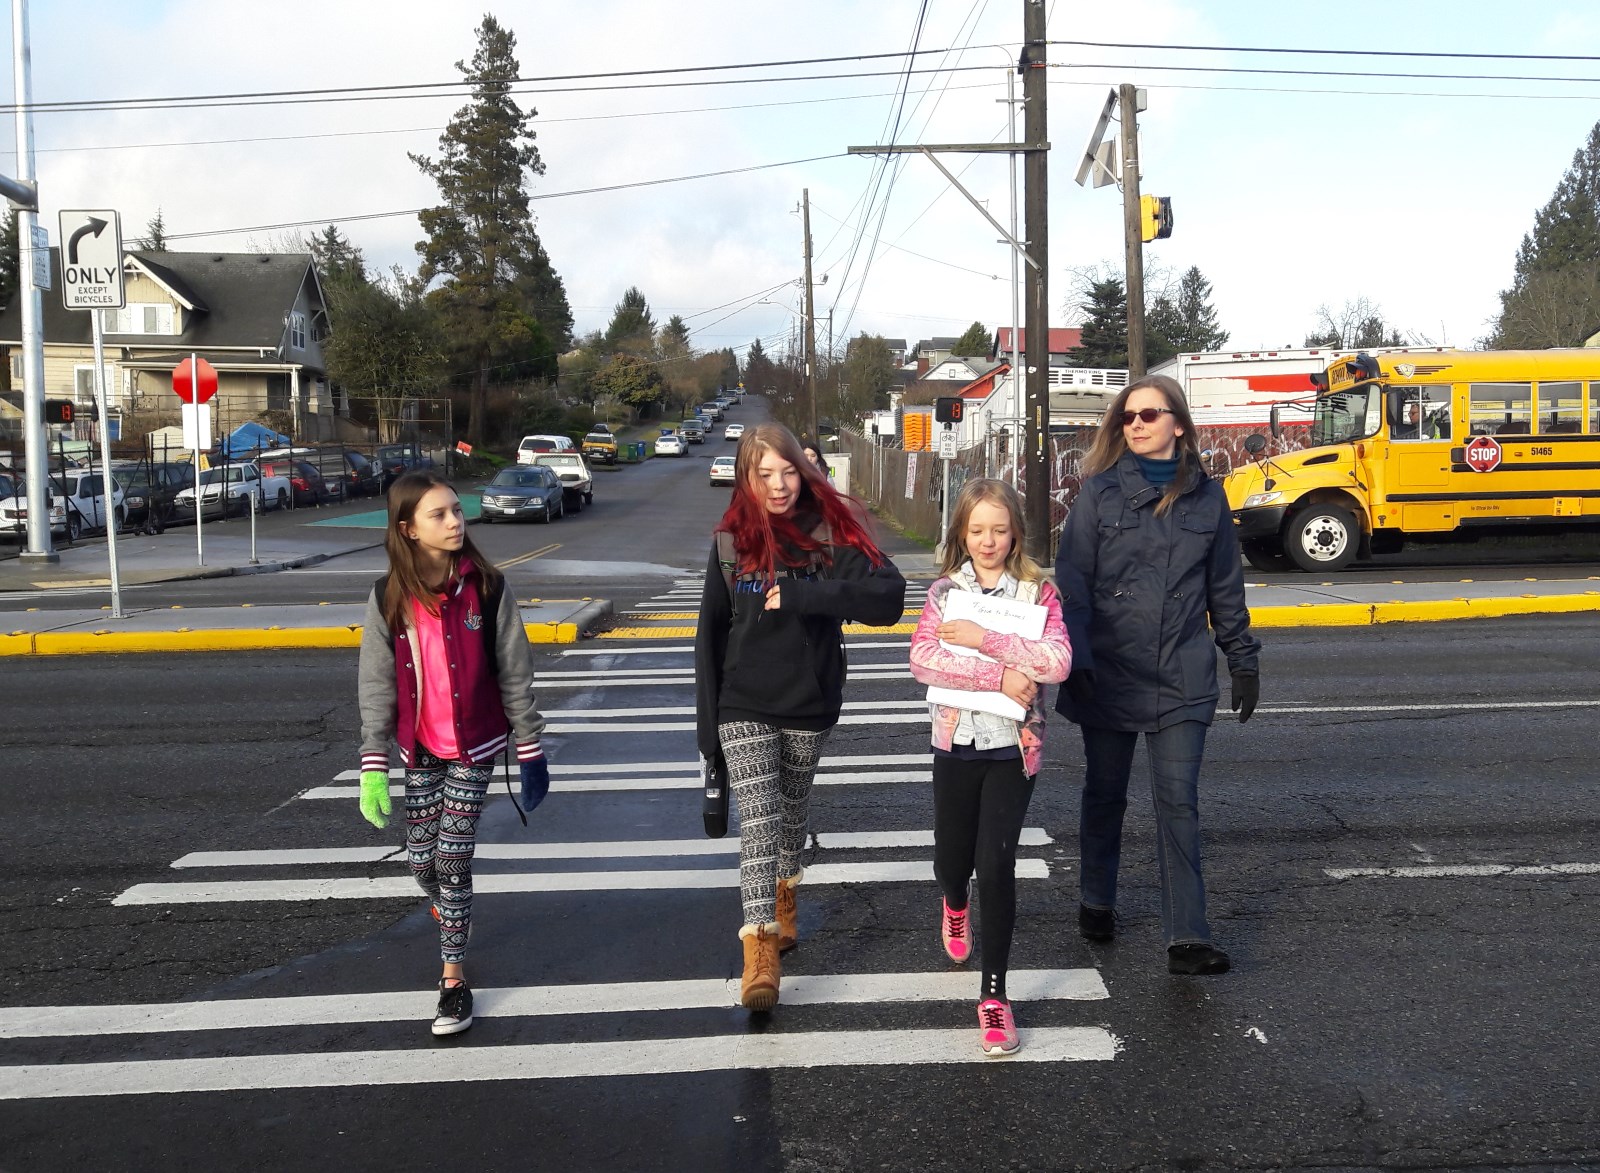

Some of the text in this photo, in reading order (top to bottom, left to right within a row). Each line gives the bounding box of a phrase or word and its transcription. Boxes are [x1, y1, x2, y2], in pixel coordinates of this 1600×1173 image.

[66, 267, 117, 285] ONLY
[78, 286, 108, 294] EXCEPT
[74, 295, 114, 304] BICYCLES
[1470, 447, 1497, 461] STOP
[1531, 447, 1553, 456] 51465
